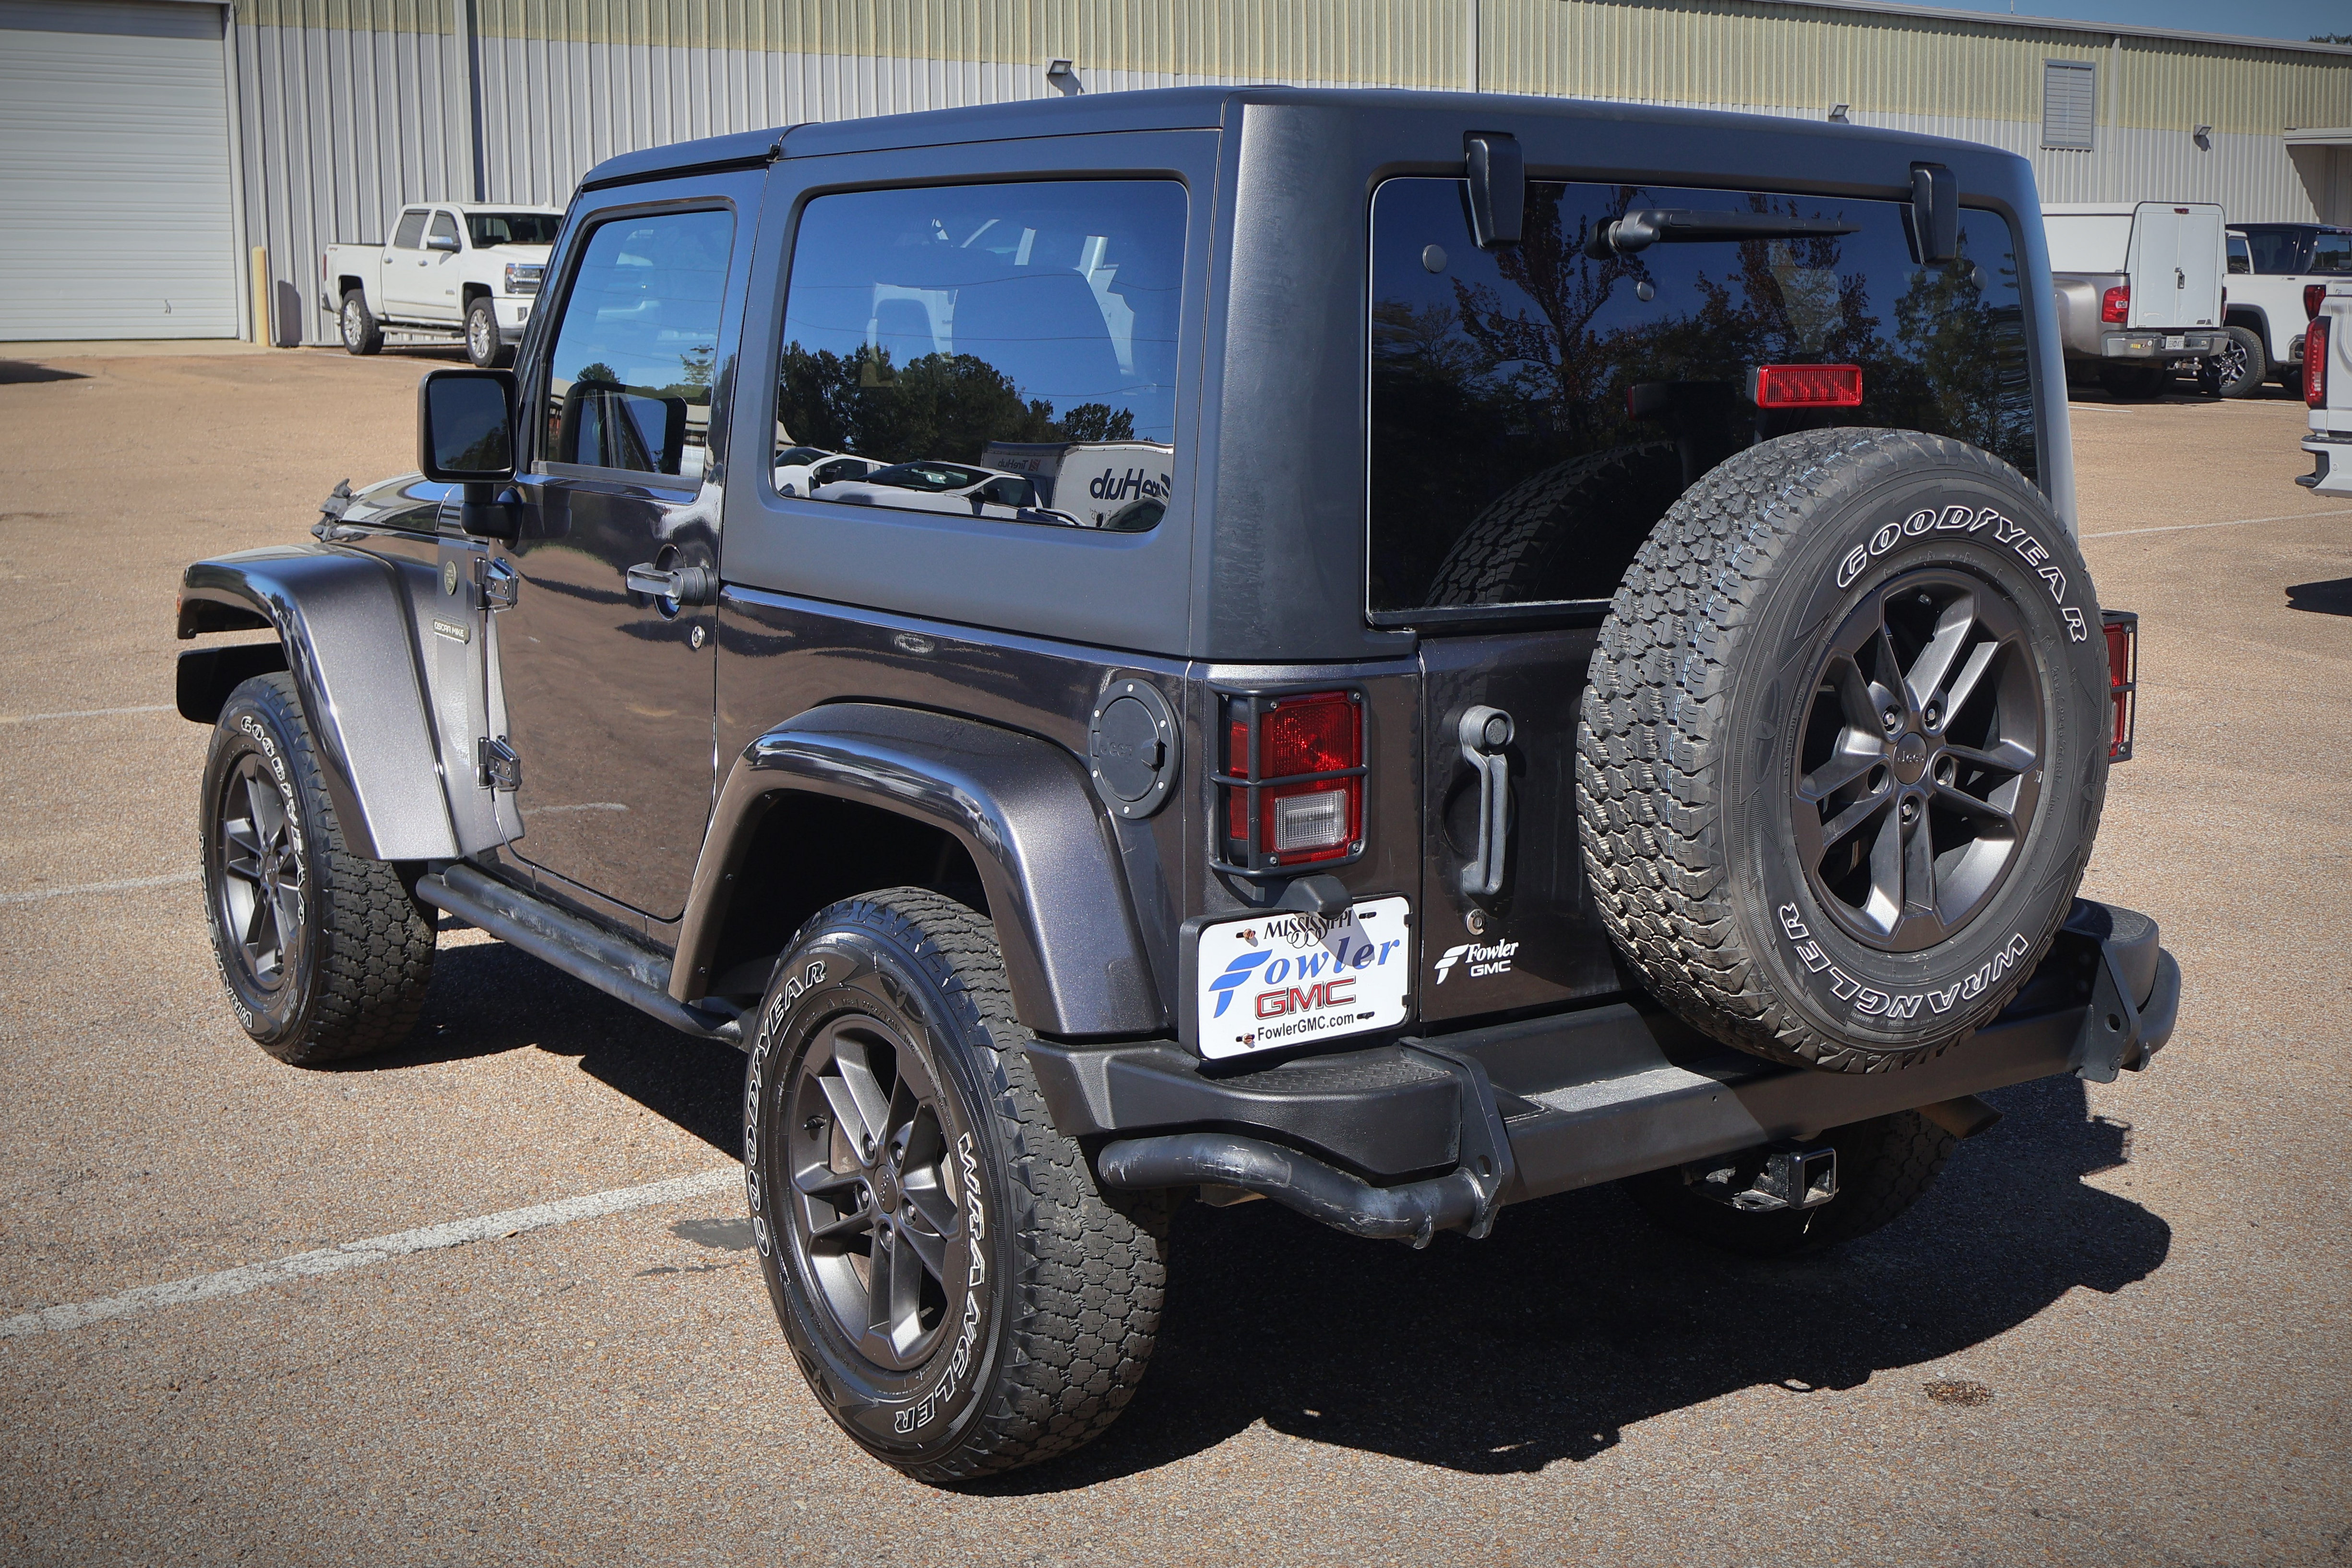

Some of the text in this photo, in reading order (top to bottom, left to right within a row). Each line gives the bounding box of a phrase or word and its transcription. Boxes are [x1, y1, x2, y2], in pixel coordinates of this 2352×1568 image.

[1837, 504, 2089, 643] GOODYEAR
[452, 626, 465, 638] MIKE
[1465, 938, 1519, 963] Fowler
[1470, 960, 1511, 977] GMC
[1778, 901, 2029, 1020] WRANGLER
[1254, 975, 1356, 1020] GMC
[1257, 1013, 1354, 1041] FowlerGMC.com
[746, 959, 828, 1258] GOODYEAR
[895, 1132, 985, 1435] WRANGLER
